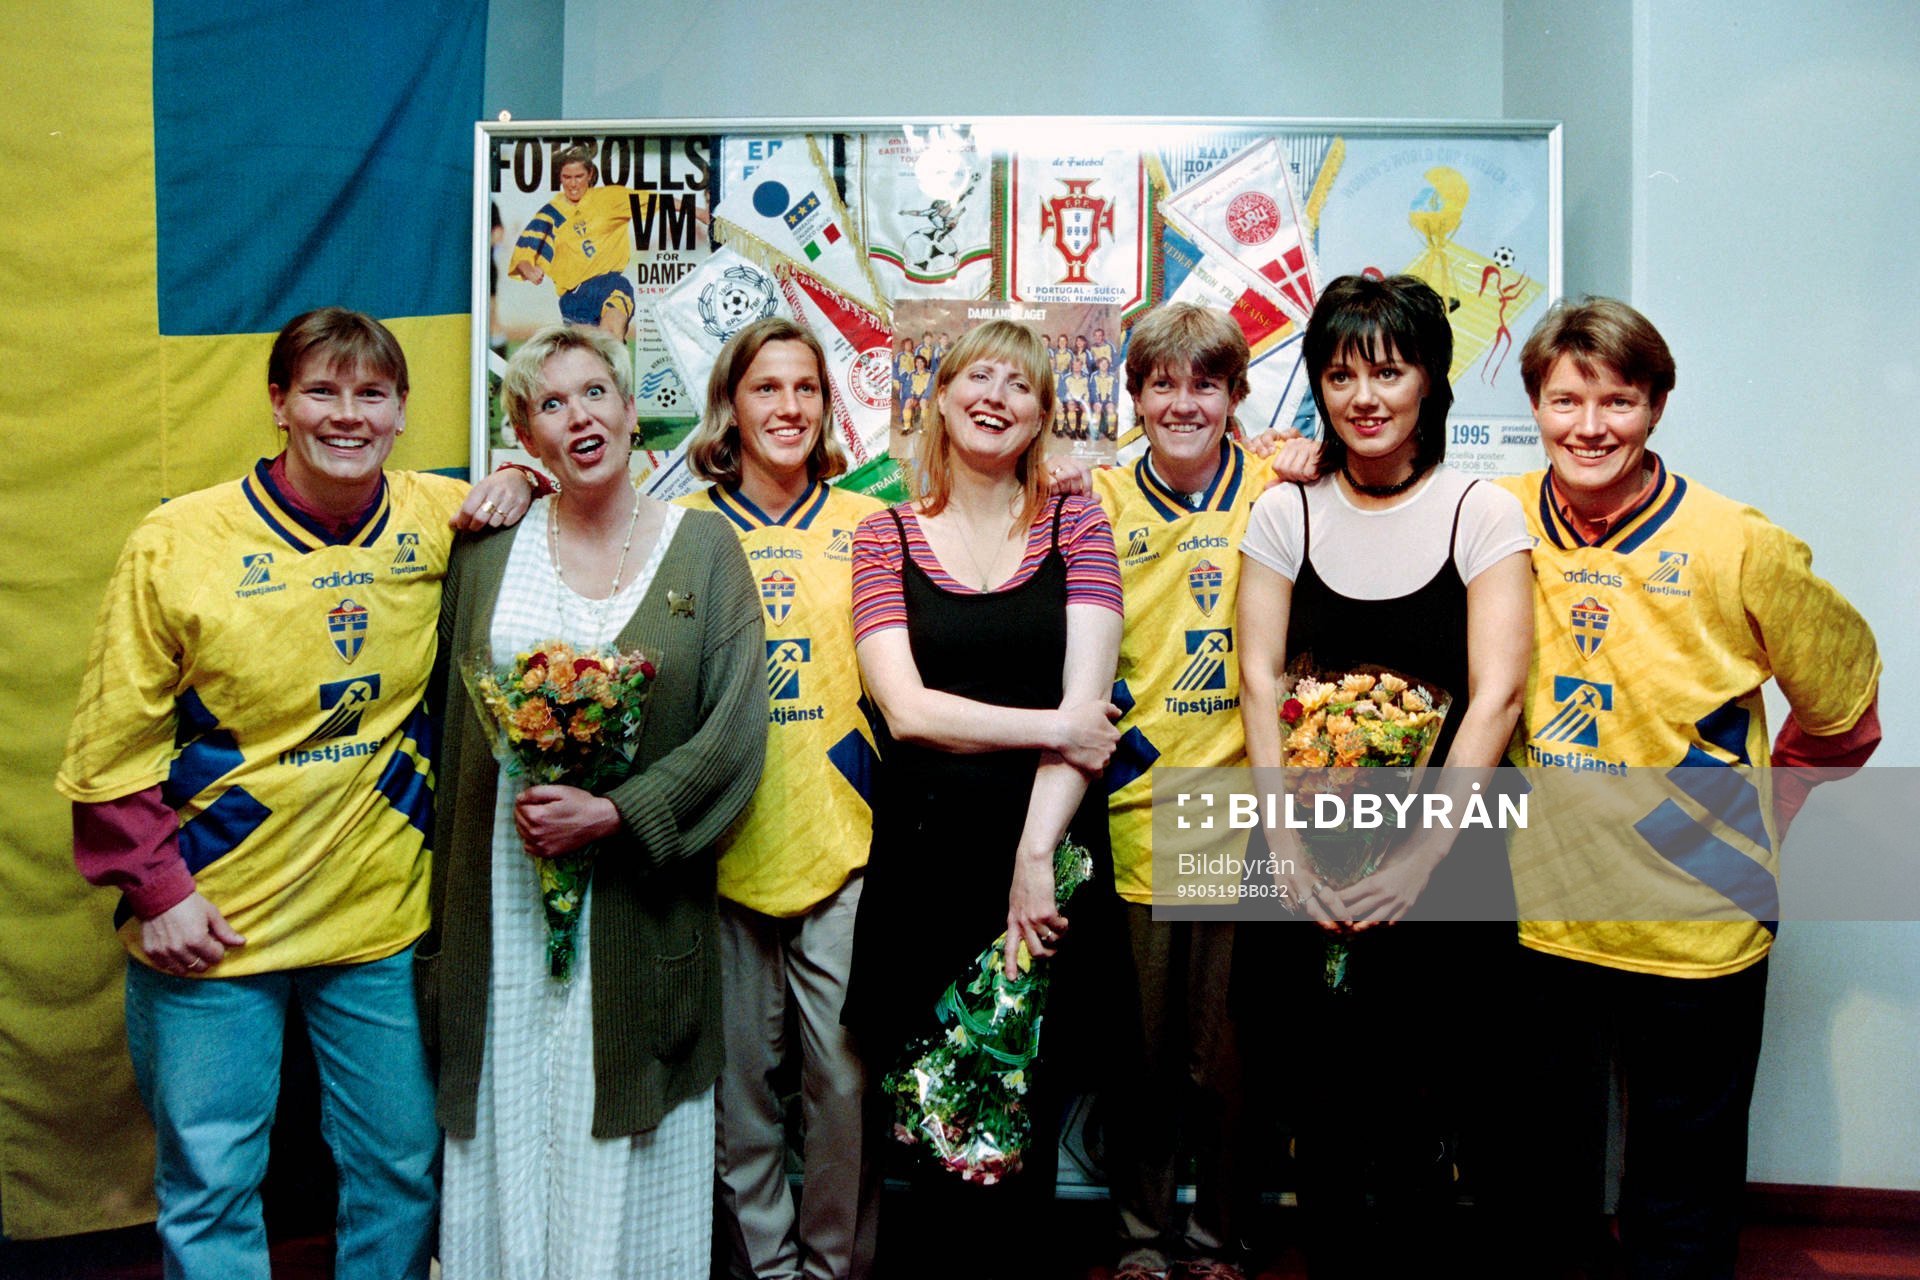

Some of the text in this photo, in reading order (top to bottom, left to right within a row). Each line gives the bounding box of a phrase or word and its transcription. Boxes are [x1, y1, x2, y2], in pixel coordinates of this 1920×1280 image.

[629, 194, 697, 251] VM
[1035, 286, 1085, 294] PORTUGAL
[967, 307, 1047, 320] DAMLANLAGET
[1451, 424, 1490, 445] 1995
[1177, 534, 1229, 552] adidas
[750, 546, 803, 560] adidas
[390, 564, 428, 575] Tipstjänst
[1563, 568, 1623, 588] adidas
[312, 570, 375, 589] adidas
[235, 583, 287, 599] Tipstjänst
[1642, 583, 1691, 597] Tipstjänst
[1165, 696, 1240, 716] Tipstjäns
[1527, 744, 1628, 778] Tipstjänst
